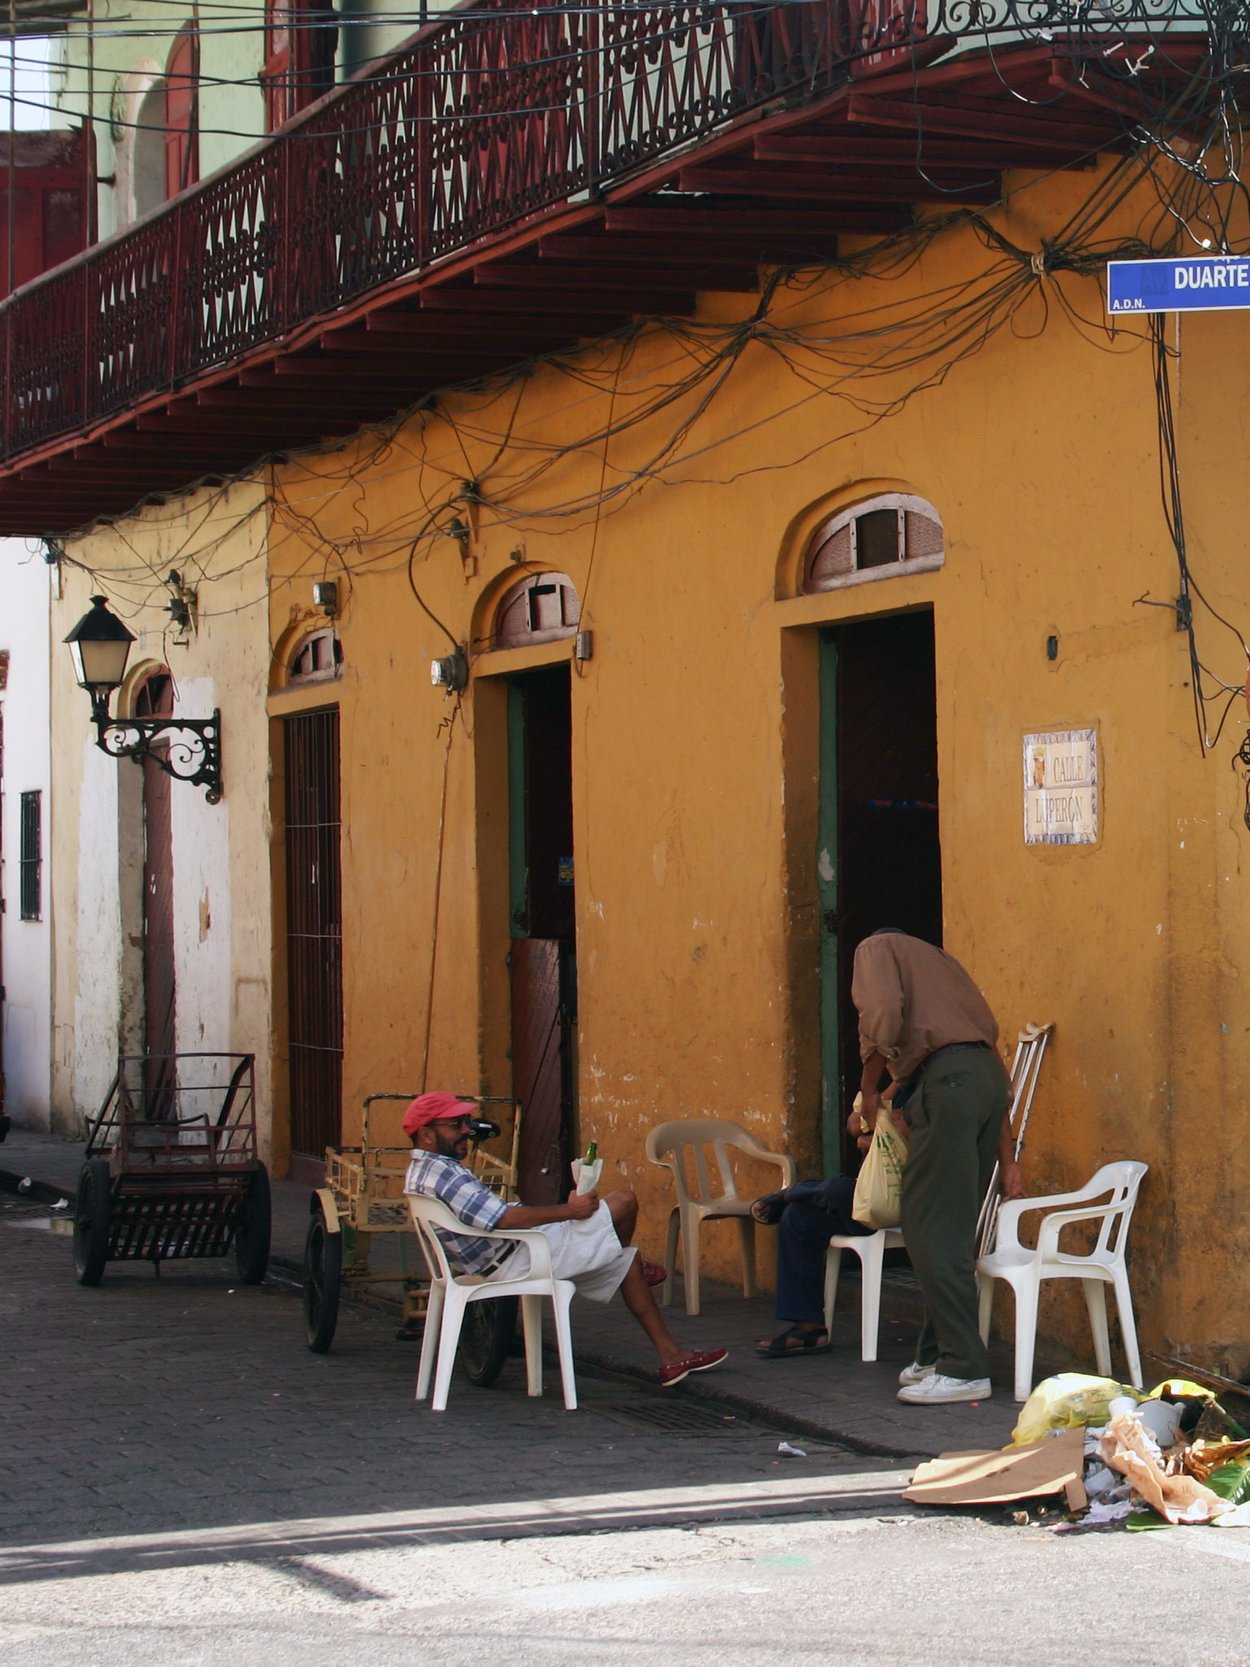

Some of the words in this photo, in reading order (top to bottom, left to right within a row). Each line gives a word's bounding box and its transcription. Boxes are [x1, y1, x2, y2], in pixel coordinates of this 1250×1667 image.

[1174, 264, 1250, 290] DUARTE
[1112, 298, 1146, 310] A.D.N.
[1053, 756, 1082, 783] CALLE
[1035, 796, 1083, 824] LUPERON
